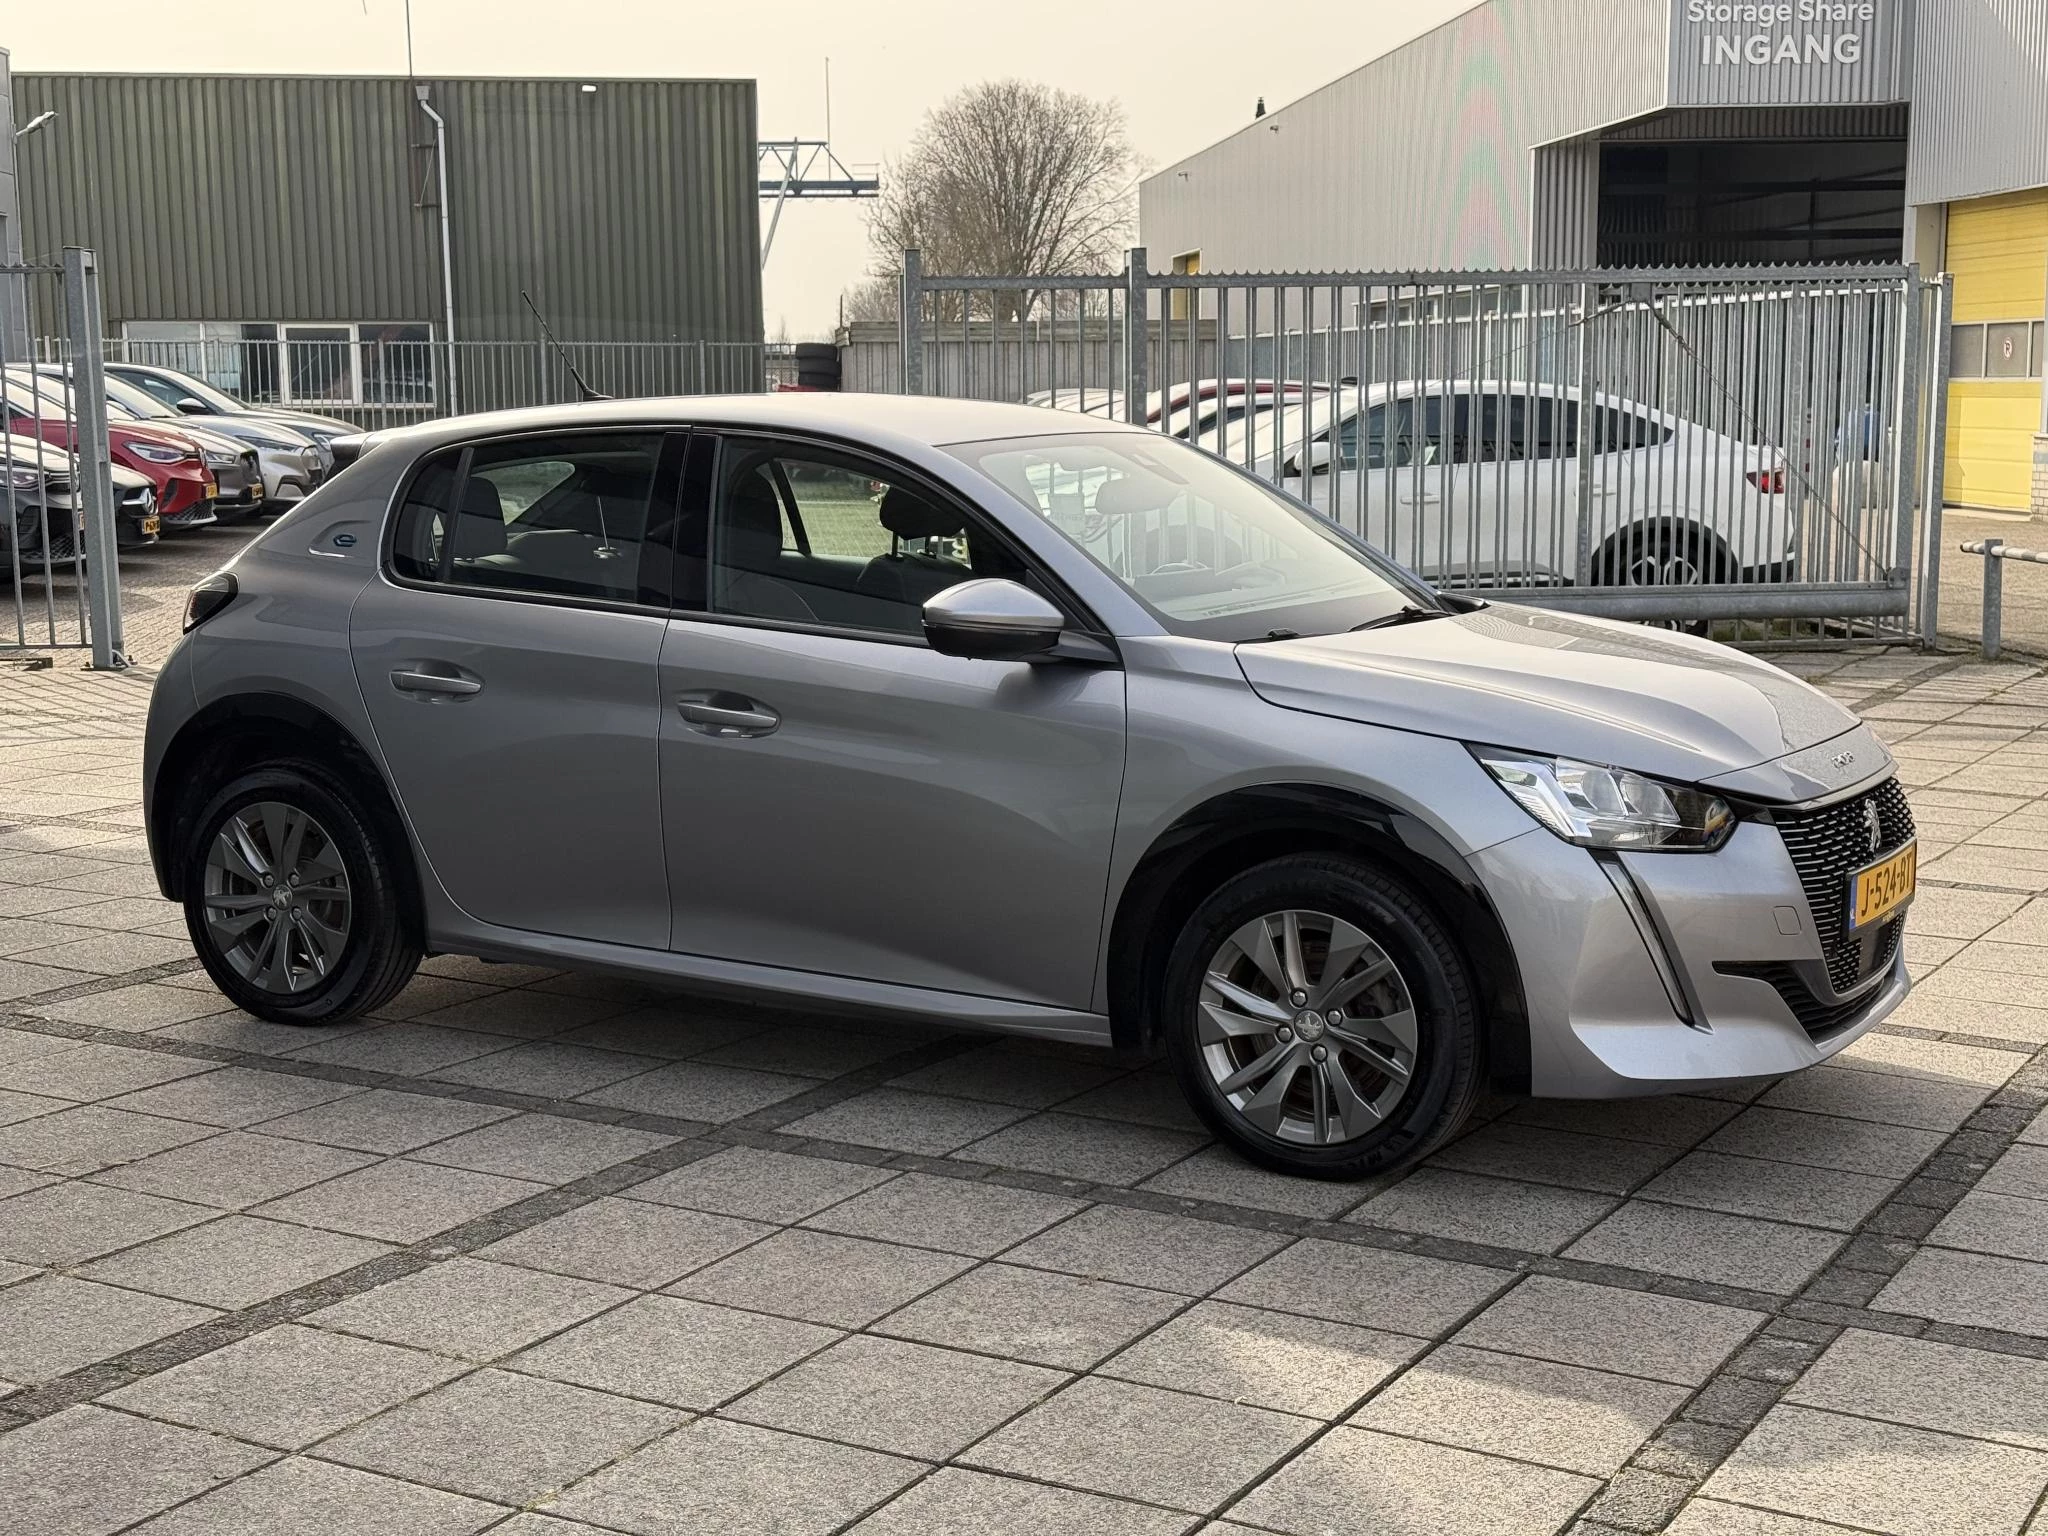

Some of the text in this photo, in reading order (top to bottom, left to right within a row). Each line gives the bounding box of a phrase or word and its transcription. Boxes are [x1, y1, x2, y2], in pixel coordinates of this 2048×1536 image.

[1687, 0, 1874, 28] Storage Share
[1702, 33, 1860, 65] INGANG
[1861, 851, 1912, 917] J-524-BT
